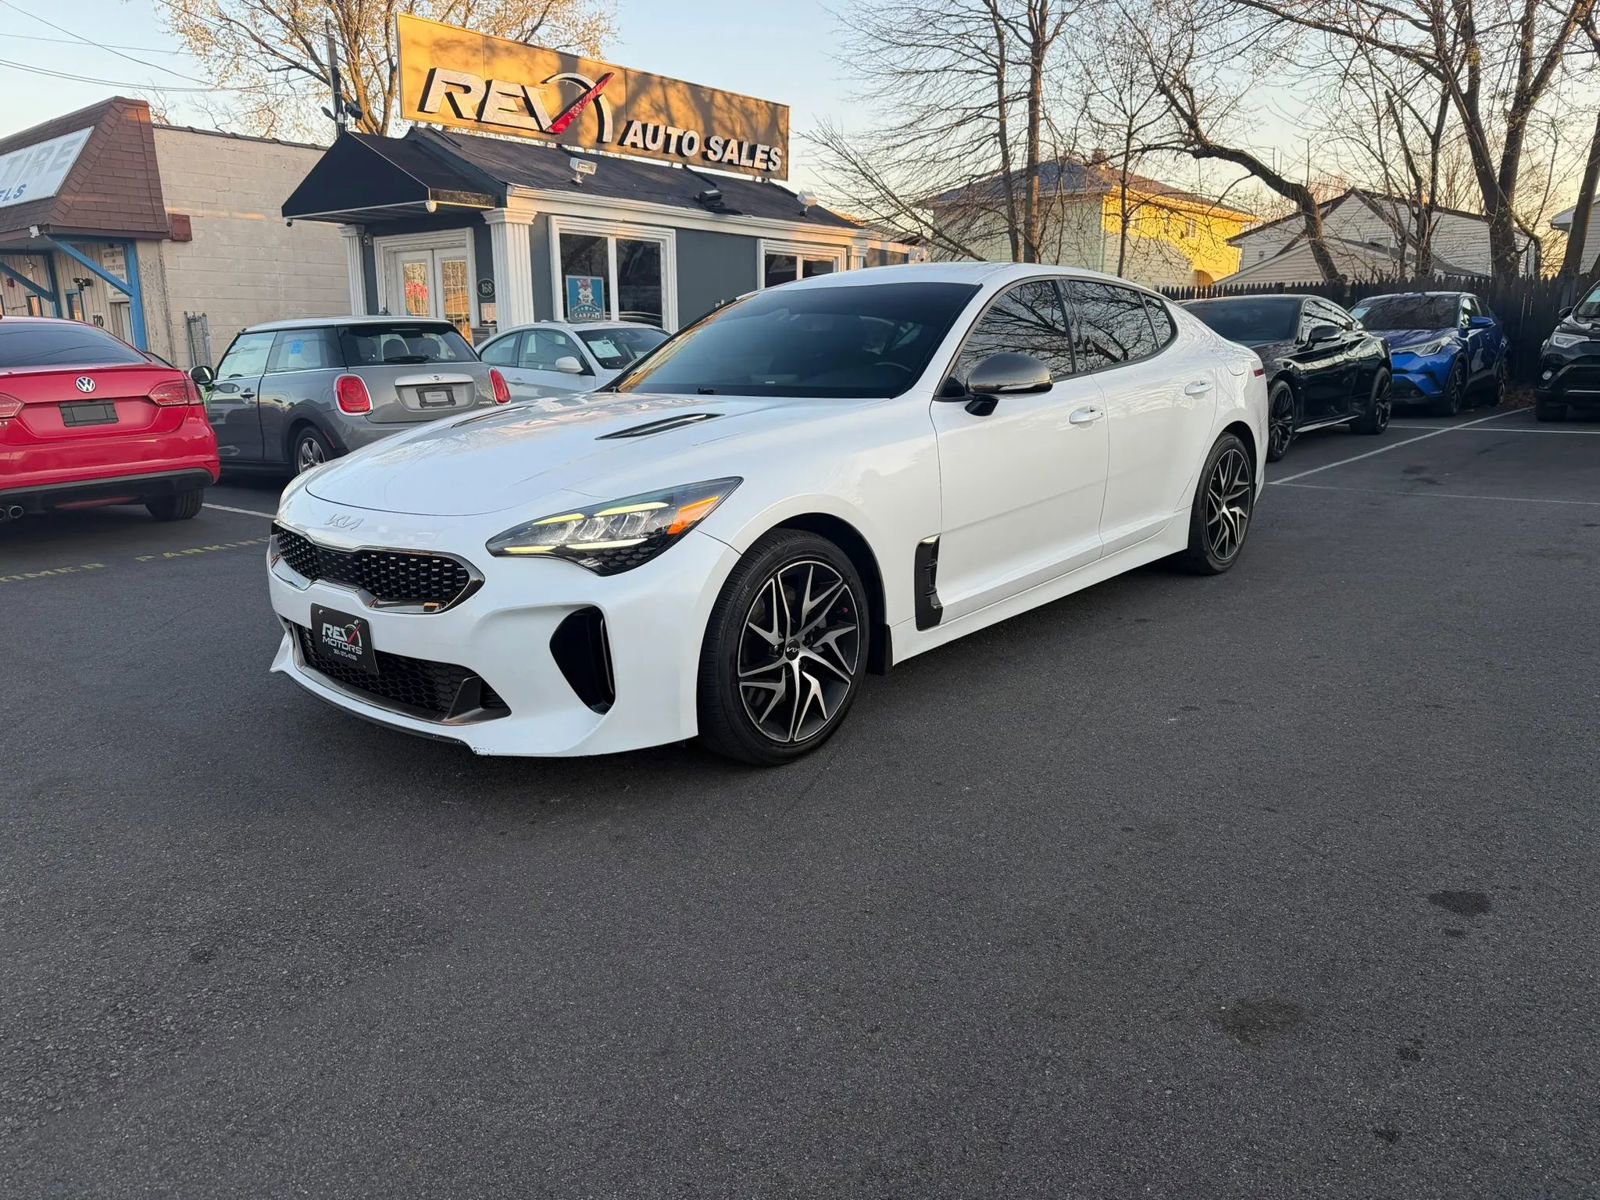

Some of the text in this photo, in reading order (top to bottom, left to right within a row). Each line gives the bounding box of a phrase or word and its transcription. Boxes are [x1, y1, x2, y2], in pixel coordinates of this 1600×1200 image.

[418, 67, 615, 135] REV
[619, 120, 783, 172] AUTO SALES
[322, 622, 362, 647] REV
[322, 635, 362, 655] MOTORS
